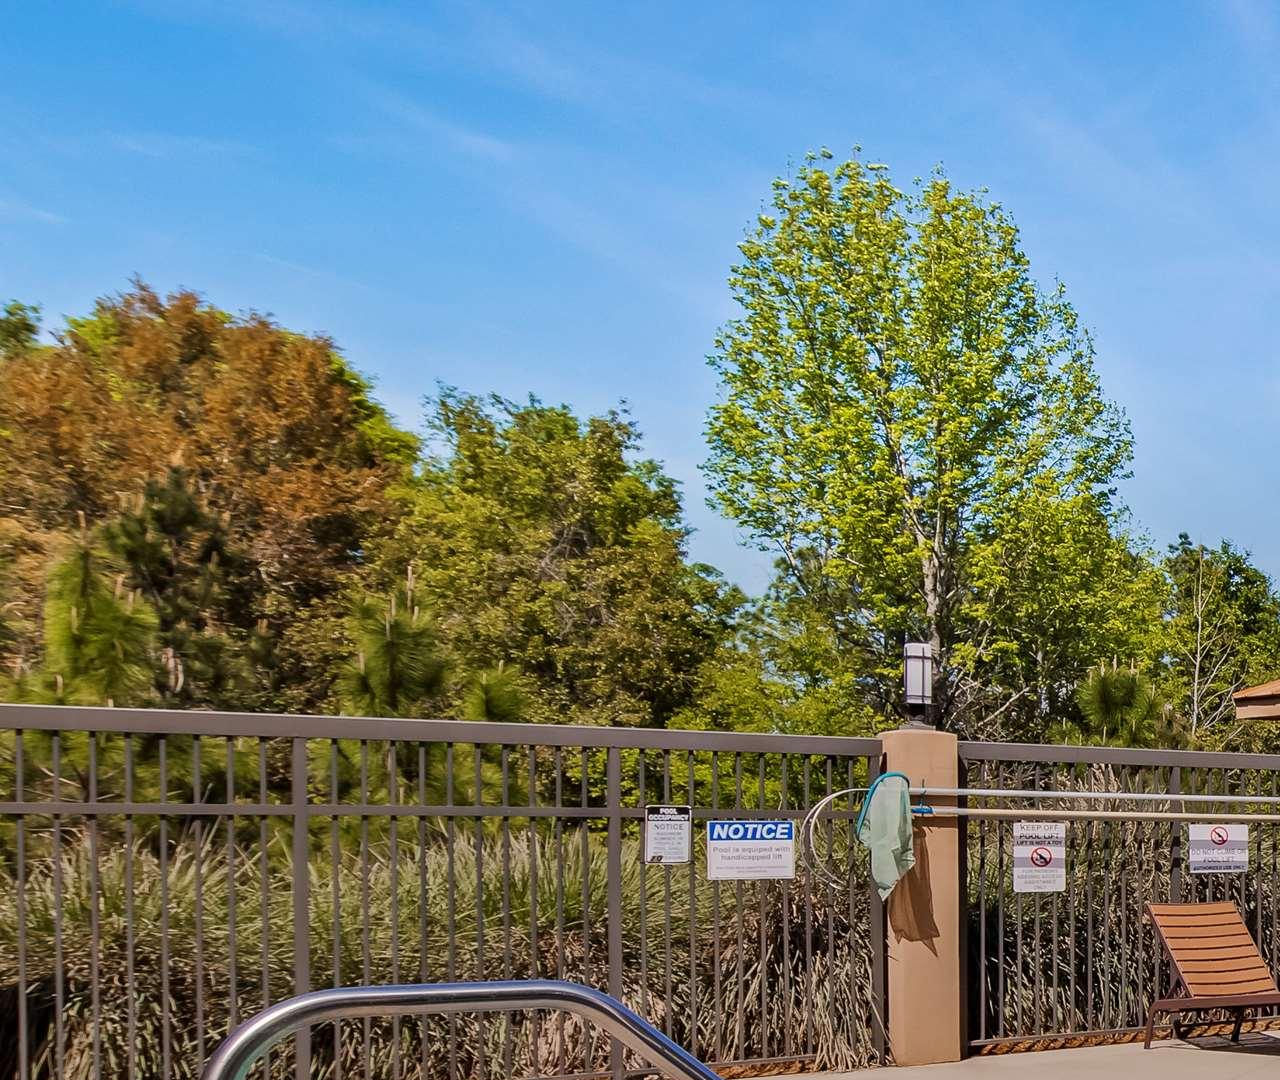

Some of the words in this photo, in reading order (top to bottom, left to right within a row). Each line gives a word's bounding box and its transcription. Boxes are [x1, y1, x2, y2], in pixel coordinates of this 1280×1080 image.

[654, 823, 685, 831] NOTICE
[712, 823, 790, 840] NOTICE
[1019, 832, 1042, 840] POOL
[720, 853, 771, 861] handicapped
